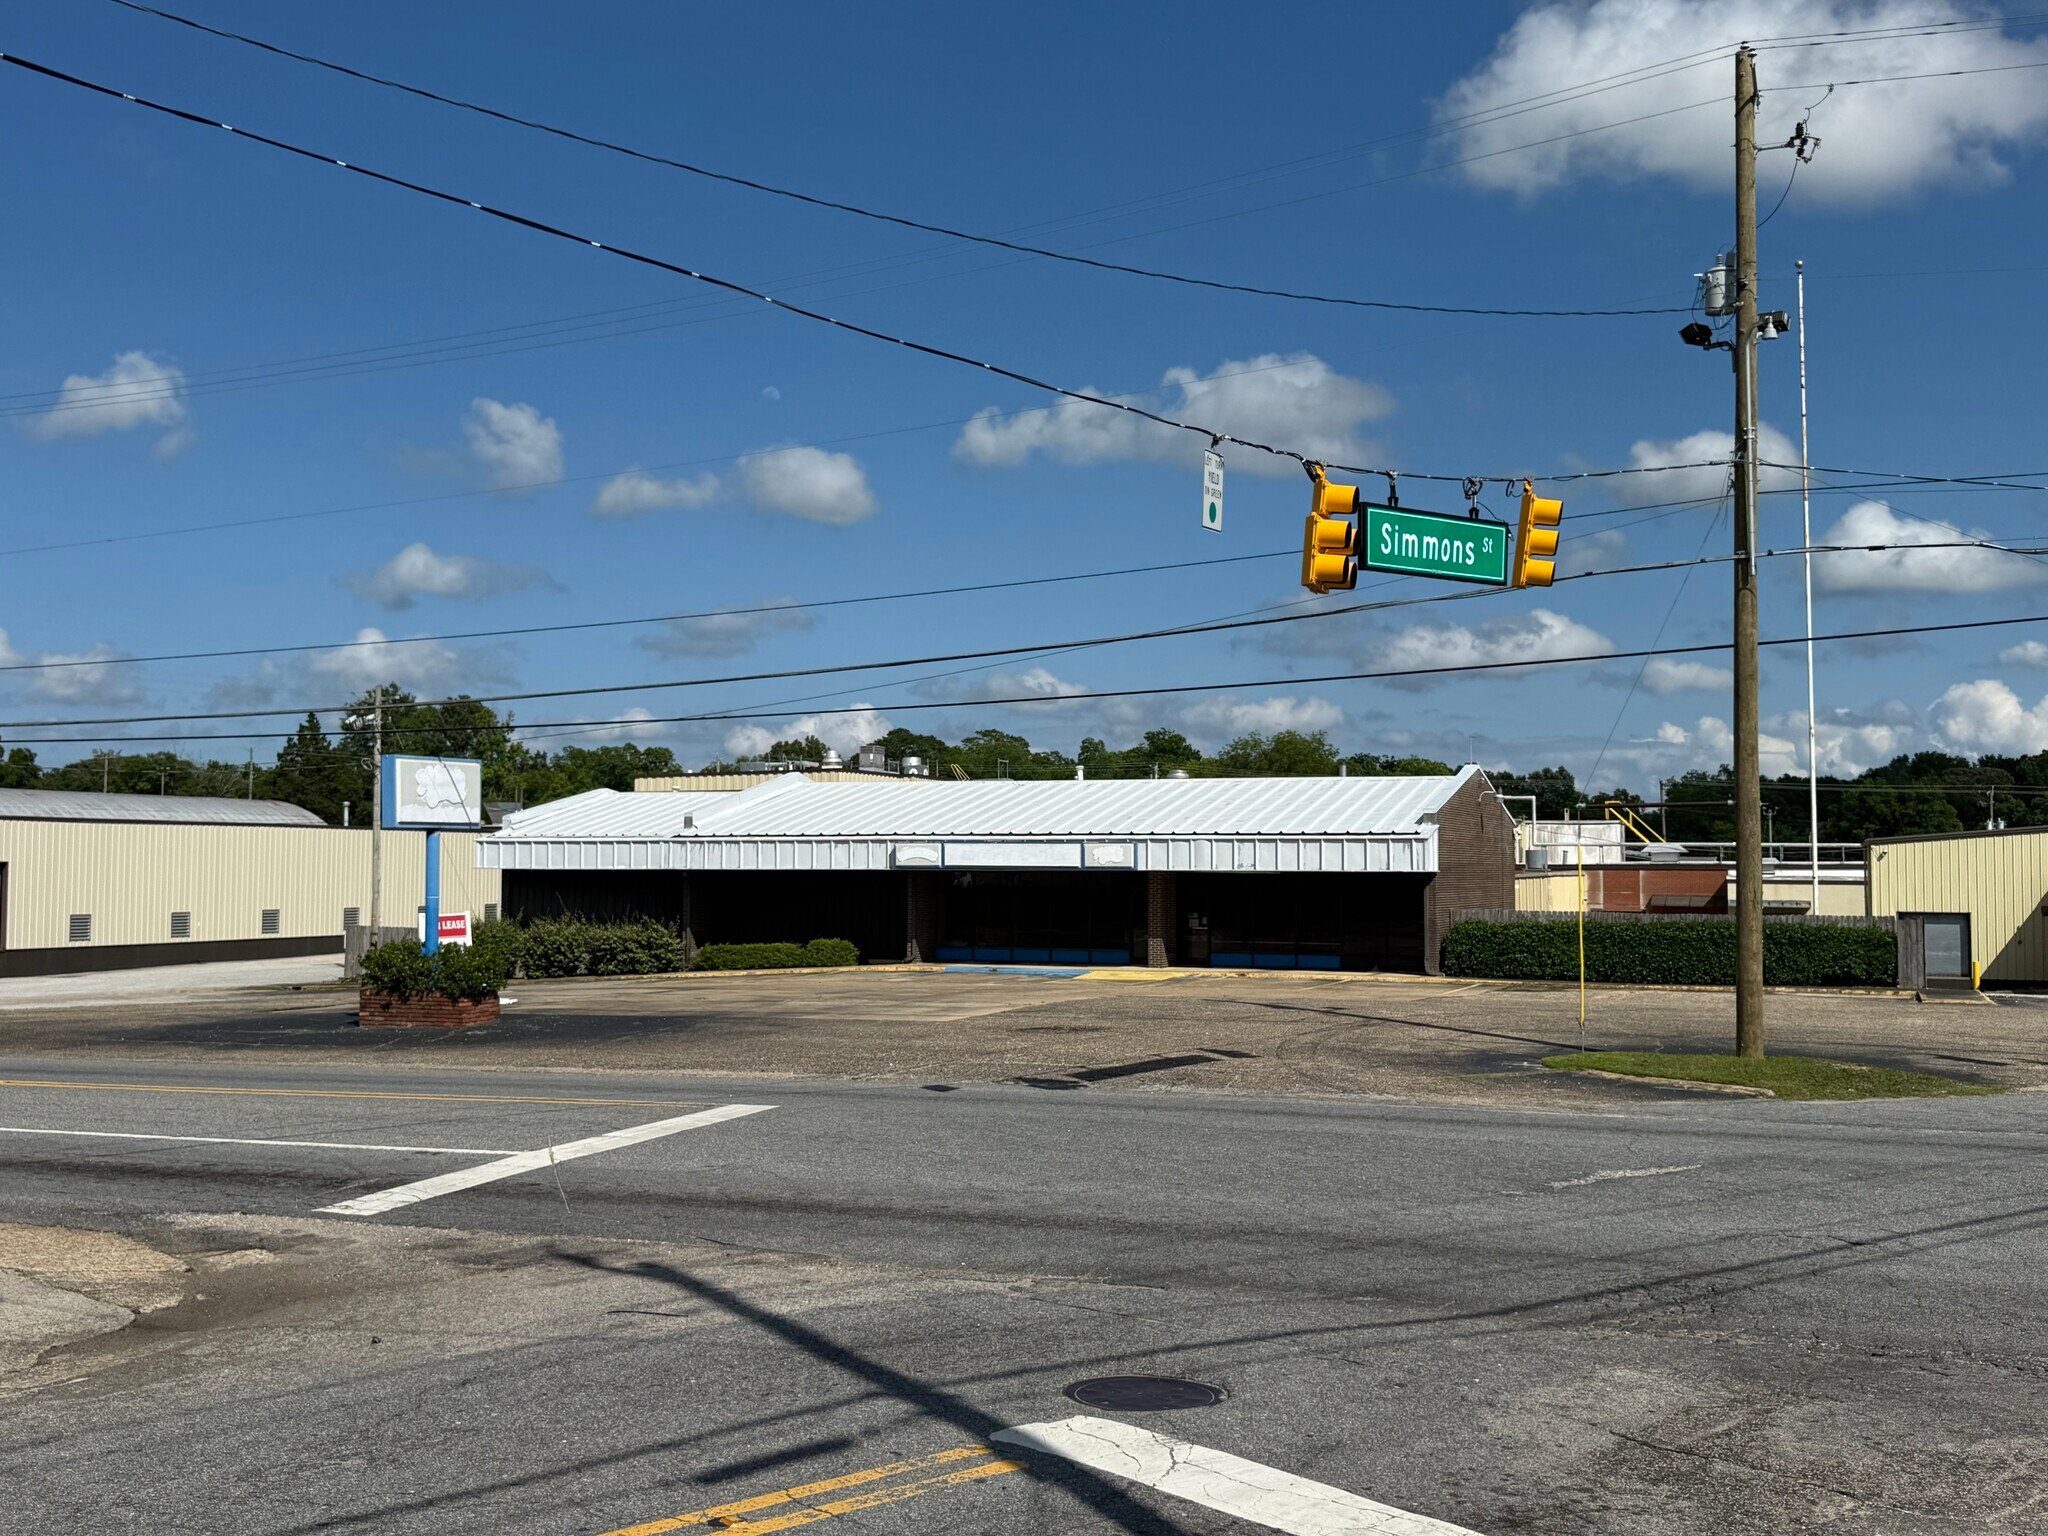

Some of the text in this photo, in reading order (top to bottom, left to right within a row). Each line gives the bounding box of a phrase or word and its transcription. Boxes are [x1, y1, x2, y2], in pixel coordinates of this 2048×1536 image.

[1208, 471, 1219, 485] YIELD
[1380, 522, 1493, 565] Simmons St
[442, 920, 466, 930] LEASE
